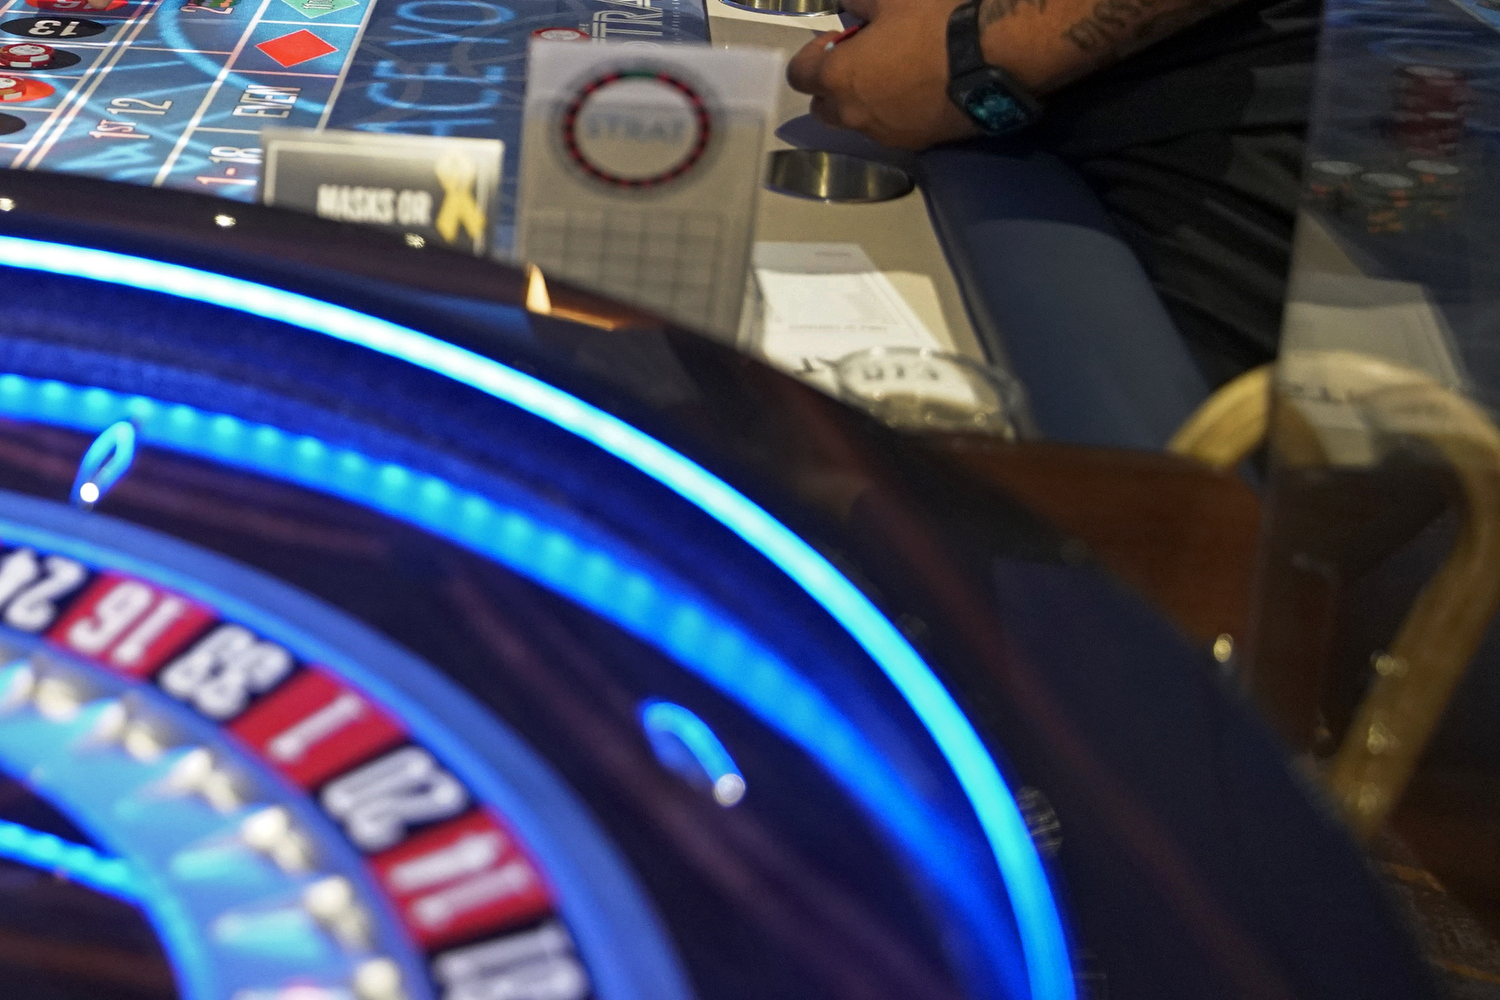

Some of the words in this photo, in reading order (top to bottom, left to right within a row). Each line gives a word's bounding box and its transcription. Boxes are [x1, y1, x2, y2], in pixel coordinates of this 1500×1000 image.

[27, 19, 81, 37] 13
[105, 96, 173, 116] 12
[232, 84, 302, 119] EVEN
[354, 60, 508, 137] ACE
[88, 118, 151, 140] 1ST
[315, 183, 397, 223] MASKS
[398, 188, 434, 226] OR
[67, 582, 186, 668] 16
[267, 692, 366, 763] 1
[322, 744, 470, 853] 20
